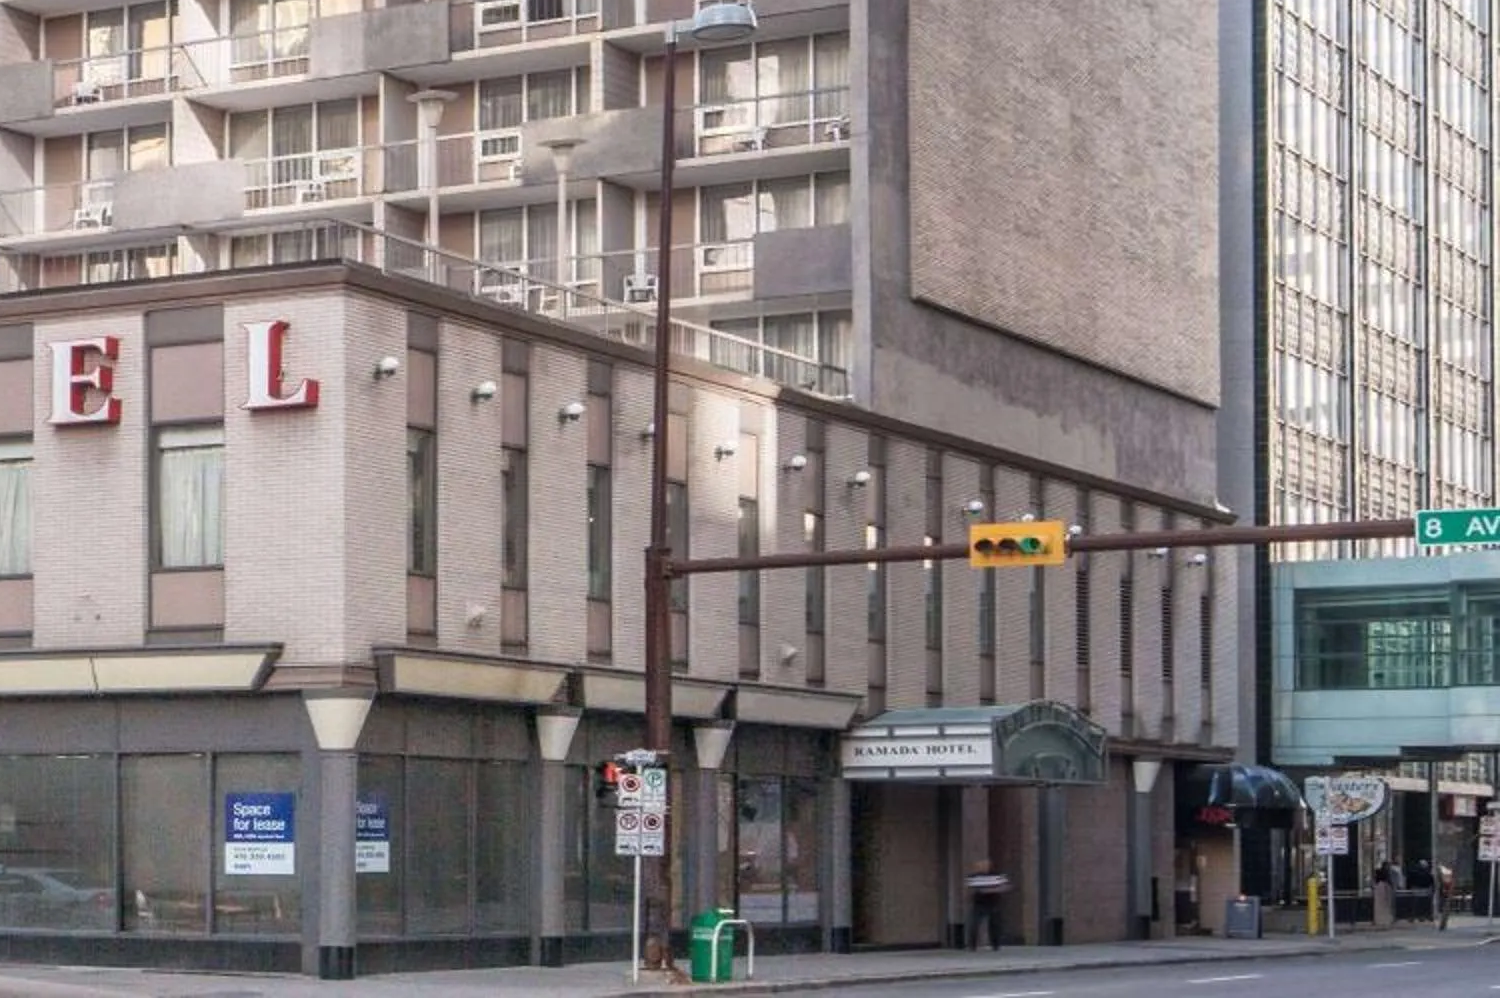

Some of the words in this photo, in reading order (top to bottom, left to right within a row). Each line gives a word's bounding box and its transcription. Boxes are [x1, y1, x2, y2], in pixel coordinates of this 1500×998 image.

[1425, 517, 1443, 539] 8
[853, 745, 919, 757] RAMADA
[926, 744, 977, 755] HOTEL
[233, 802, 271, 817] Space
[233, 818, 249, 831] for
[253, 818, 286, 831] lease
